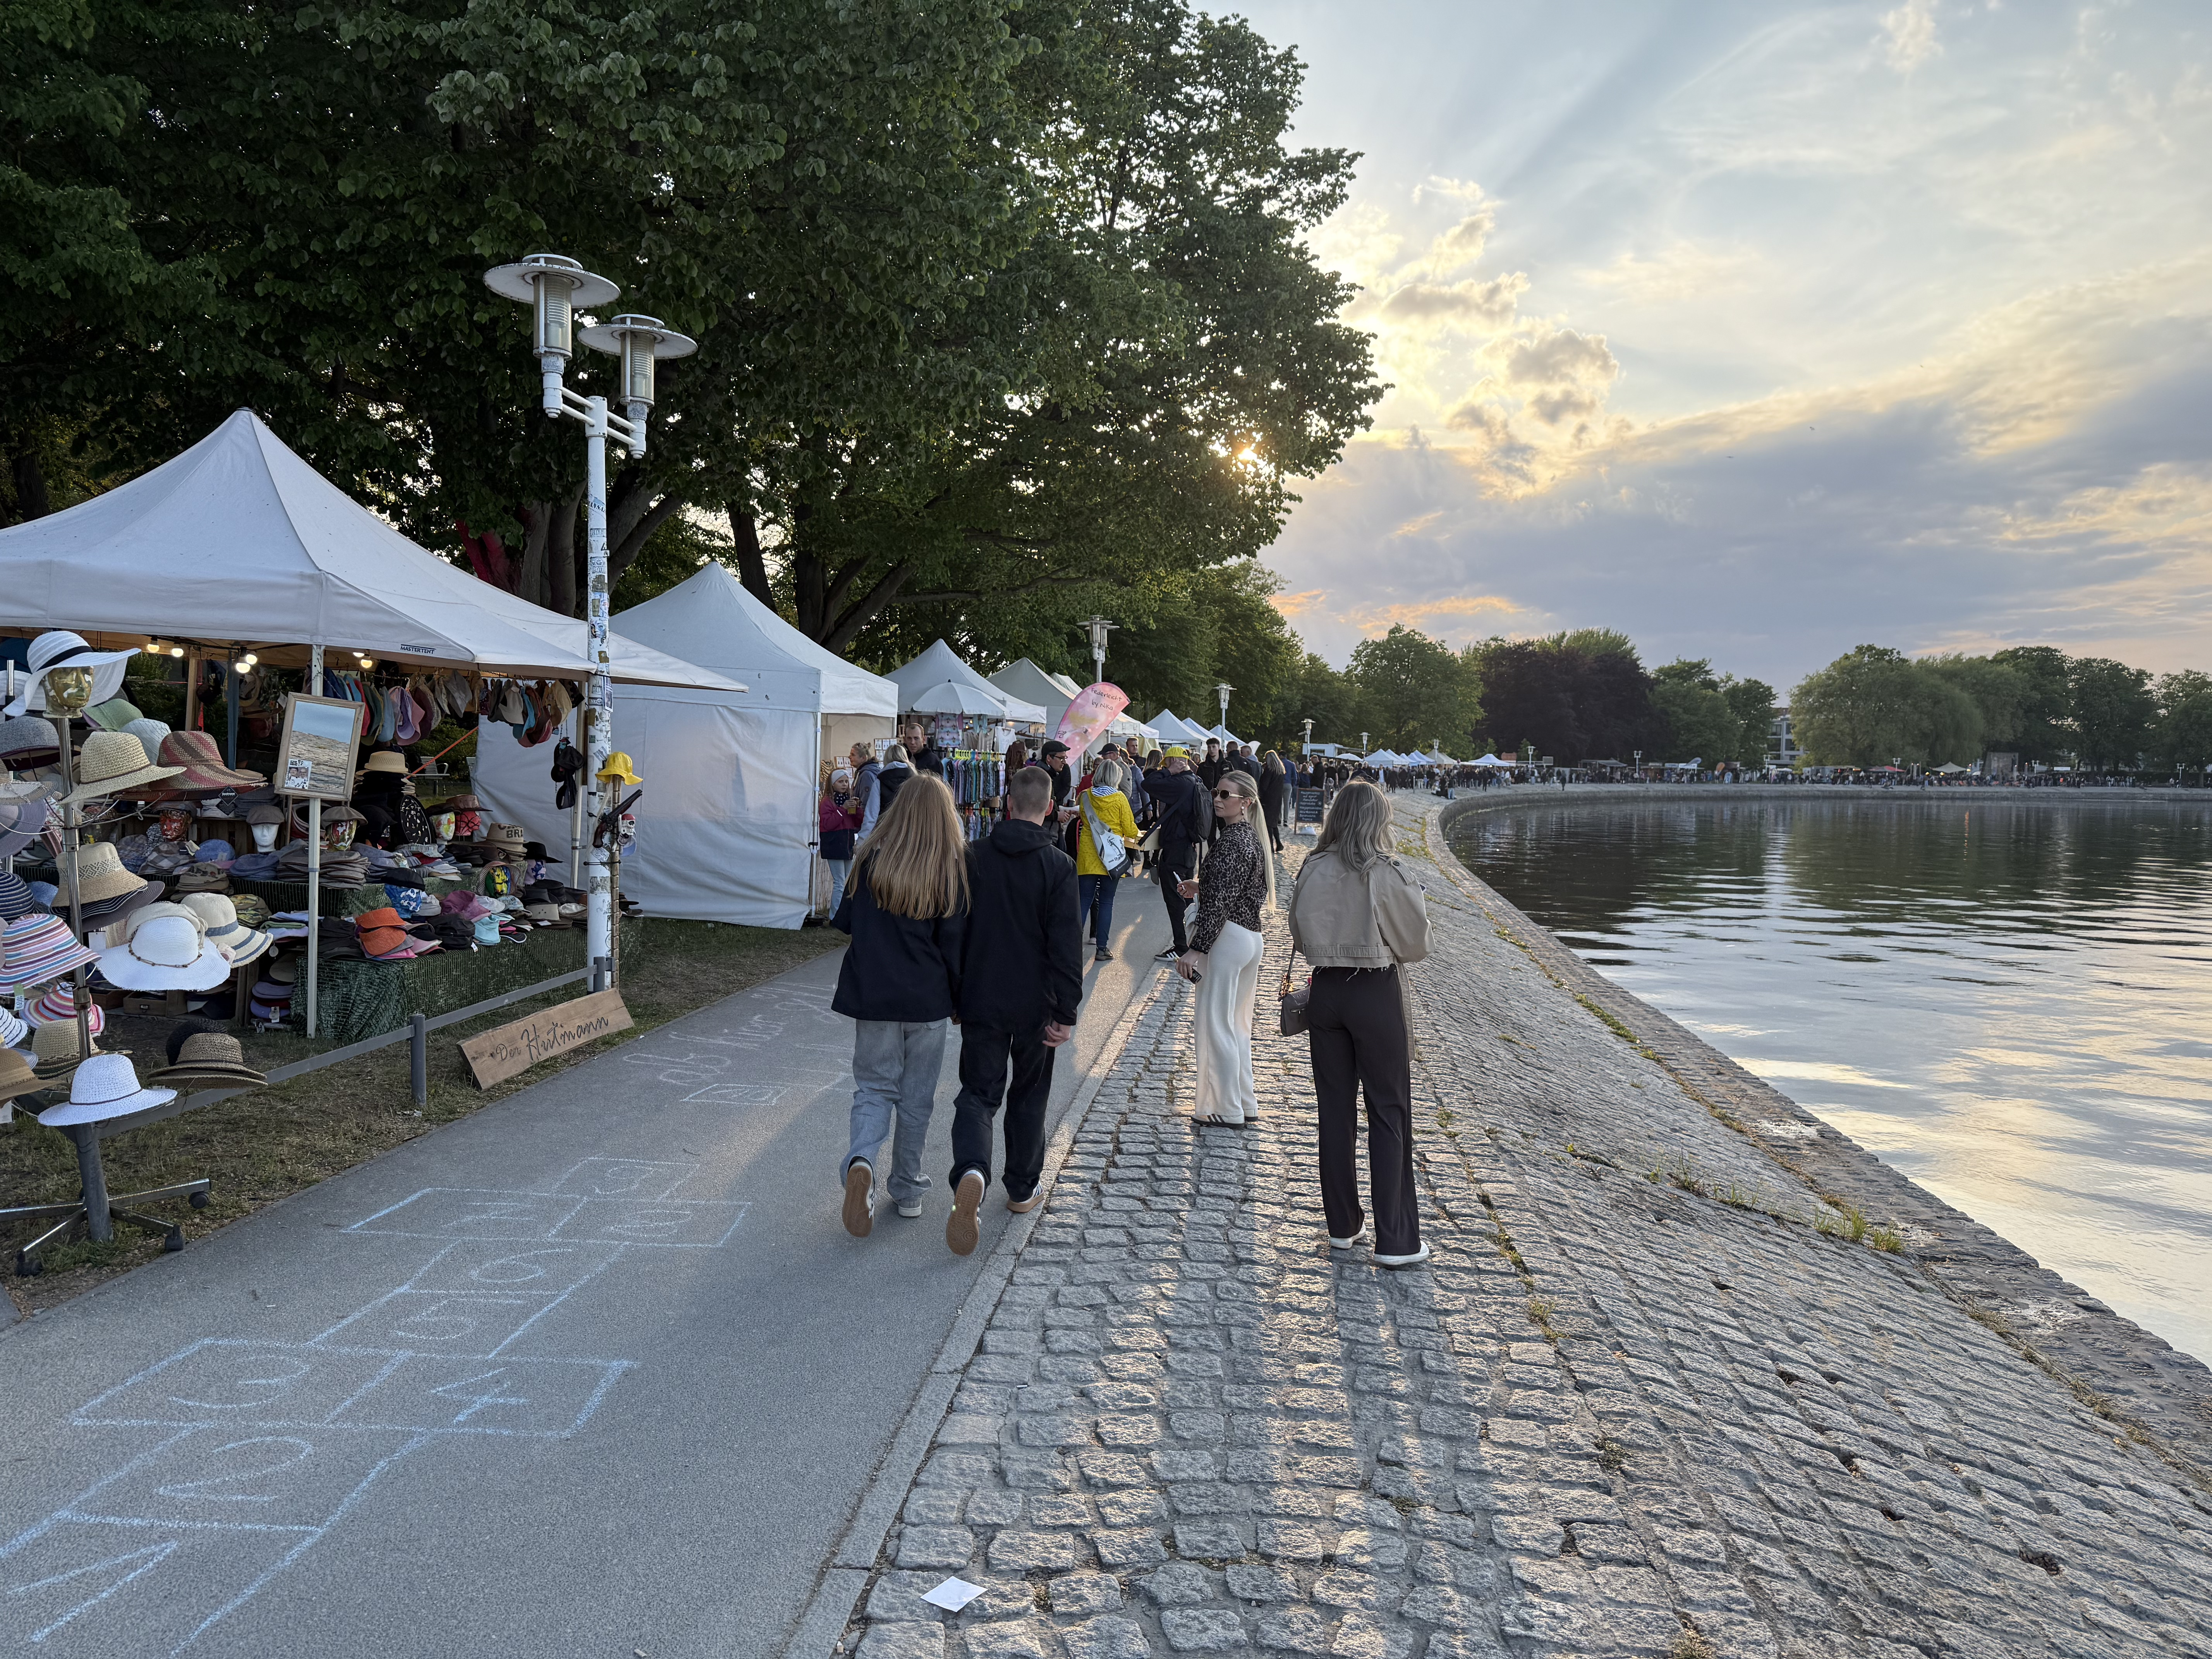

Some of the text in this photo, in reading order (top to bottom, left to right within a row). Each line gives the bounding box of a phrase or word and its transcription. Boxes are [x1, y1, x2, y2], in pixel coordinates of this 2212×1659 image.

[400, 646, 435, 654] MASTERTENT
[1091, 688, 1122, 701] Federleicht
[1092, 699, 1098, 708] by
[520, 1017, 608, 1061] Hutmann
[469, 1249, 572, 1283] 6
[390, 1298, 525, 1340] 5
[169, 1355, 528, 1424] 3 4
[156, 1435, 313, 1501] 2
